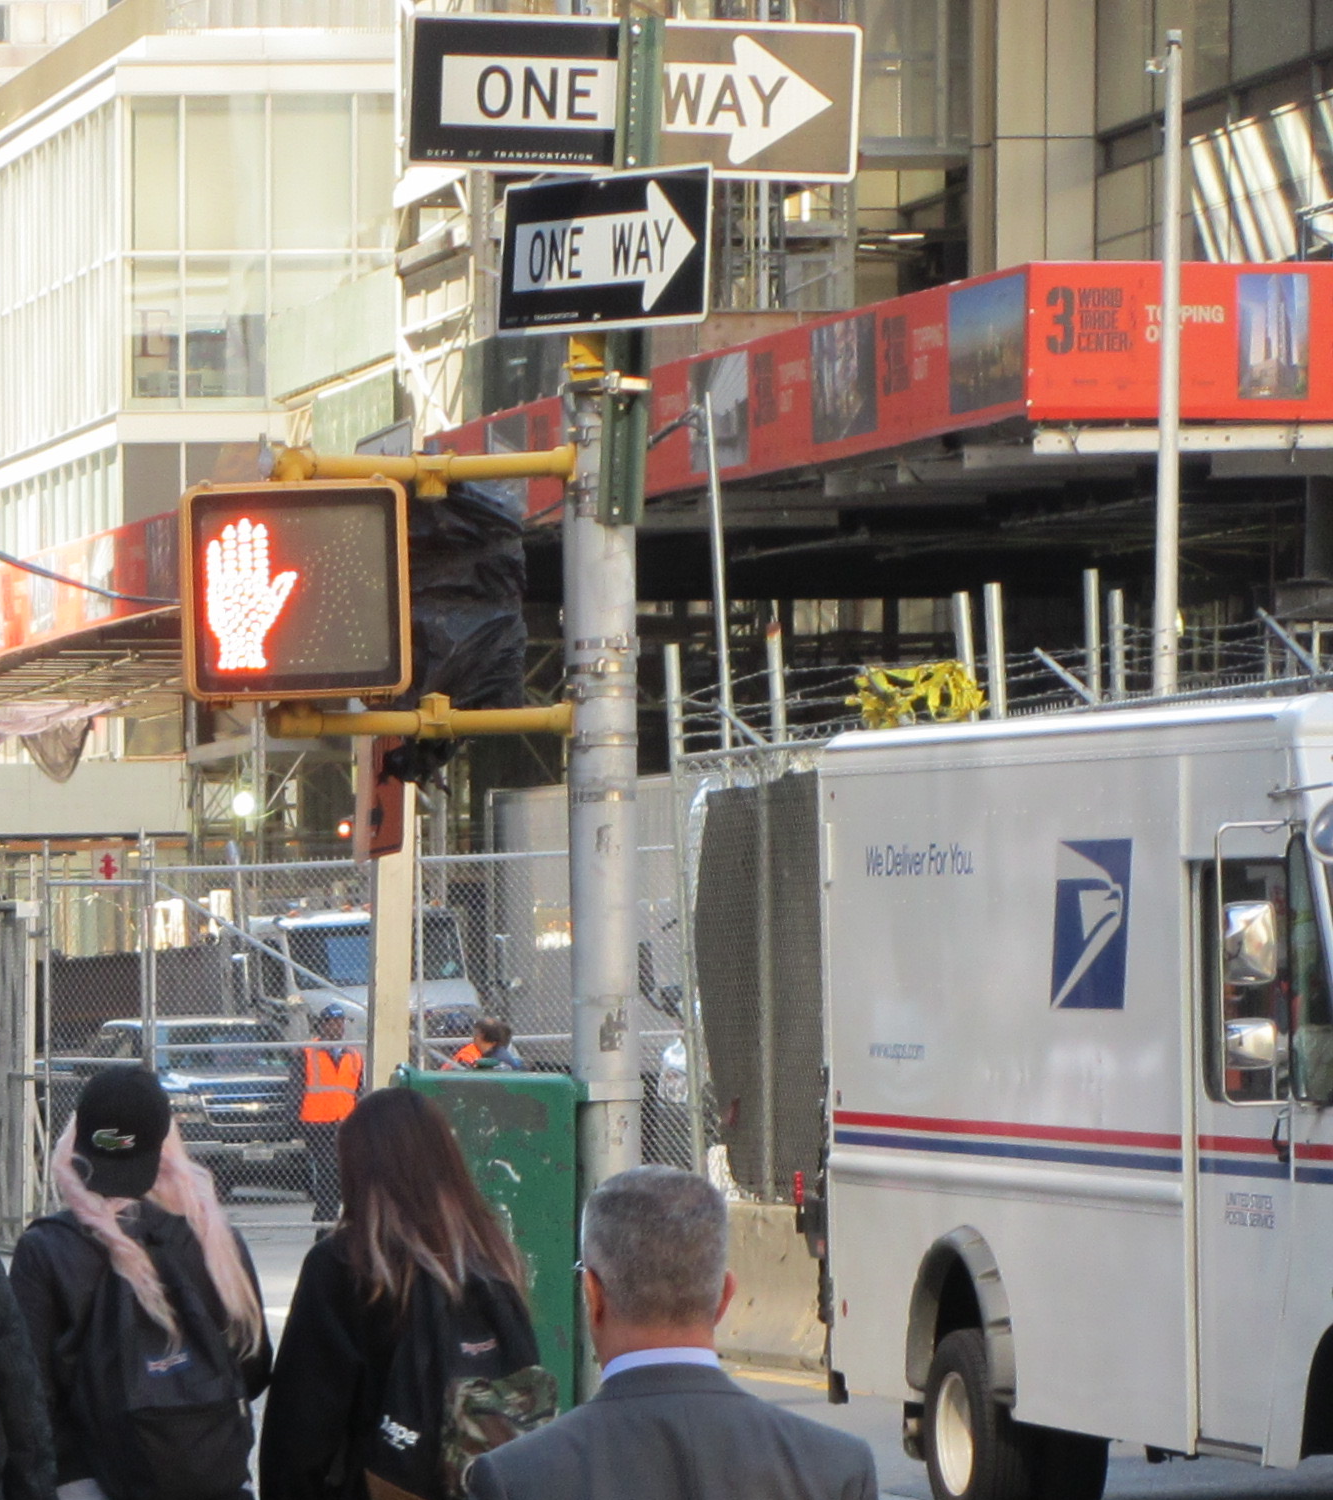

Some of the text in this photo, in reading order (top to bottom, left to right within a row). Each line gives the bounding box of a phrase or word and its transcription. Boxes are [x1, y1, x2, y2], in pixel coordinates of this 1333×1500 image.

[476, 65, 789, 129] ONE WAY
[426, 149, 594, 162] DEPT OF TRANSPORTATION
[529, 218, 675, 284] ONE WAY
[1077, 288, 1123, 309] WORLD
[1045, 286, 1075, 355] 3
[1077, 310, 1119, 331] TRADE
[1077, 332, 1129, 353] CENTER
[865, 842, 974, 877] We Deliver For You.
